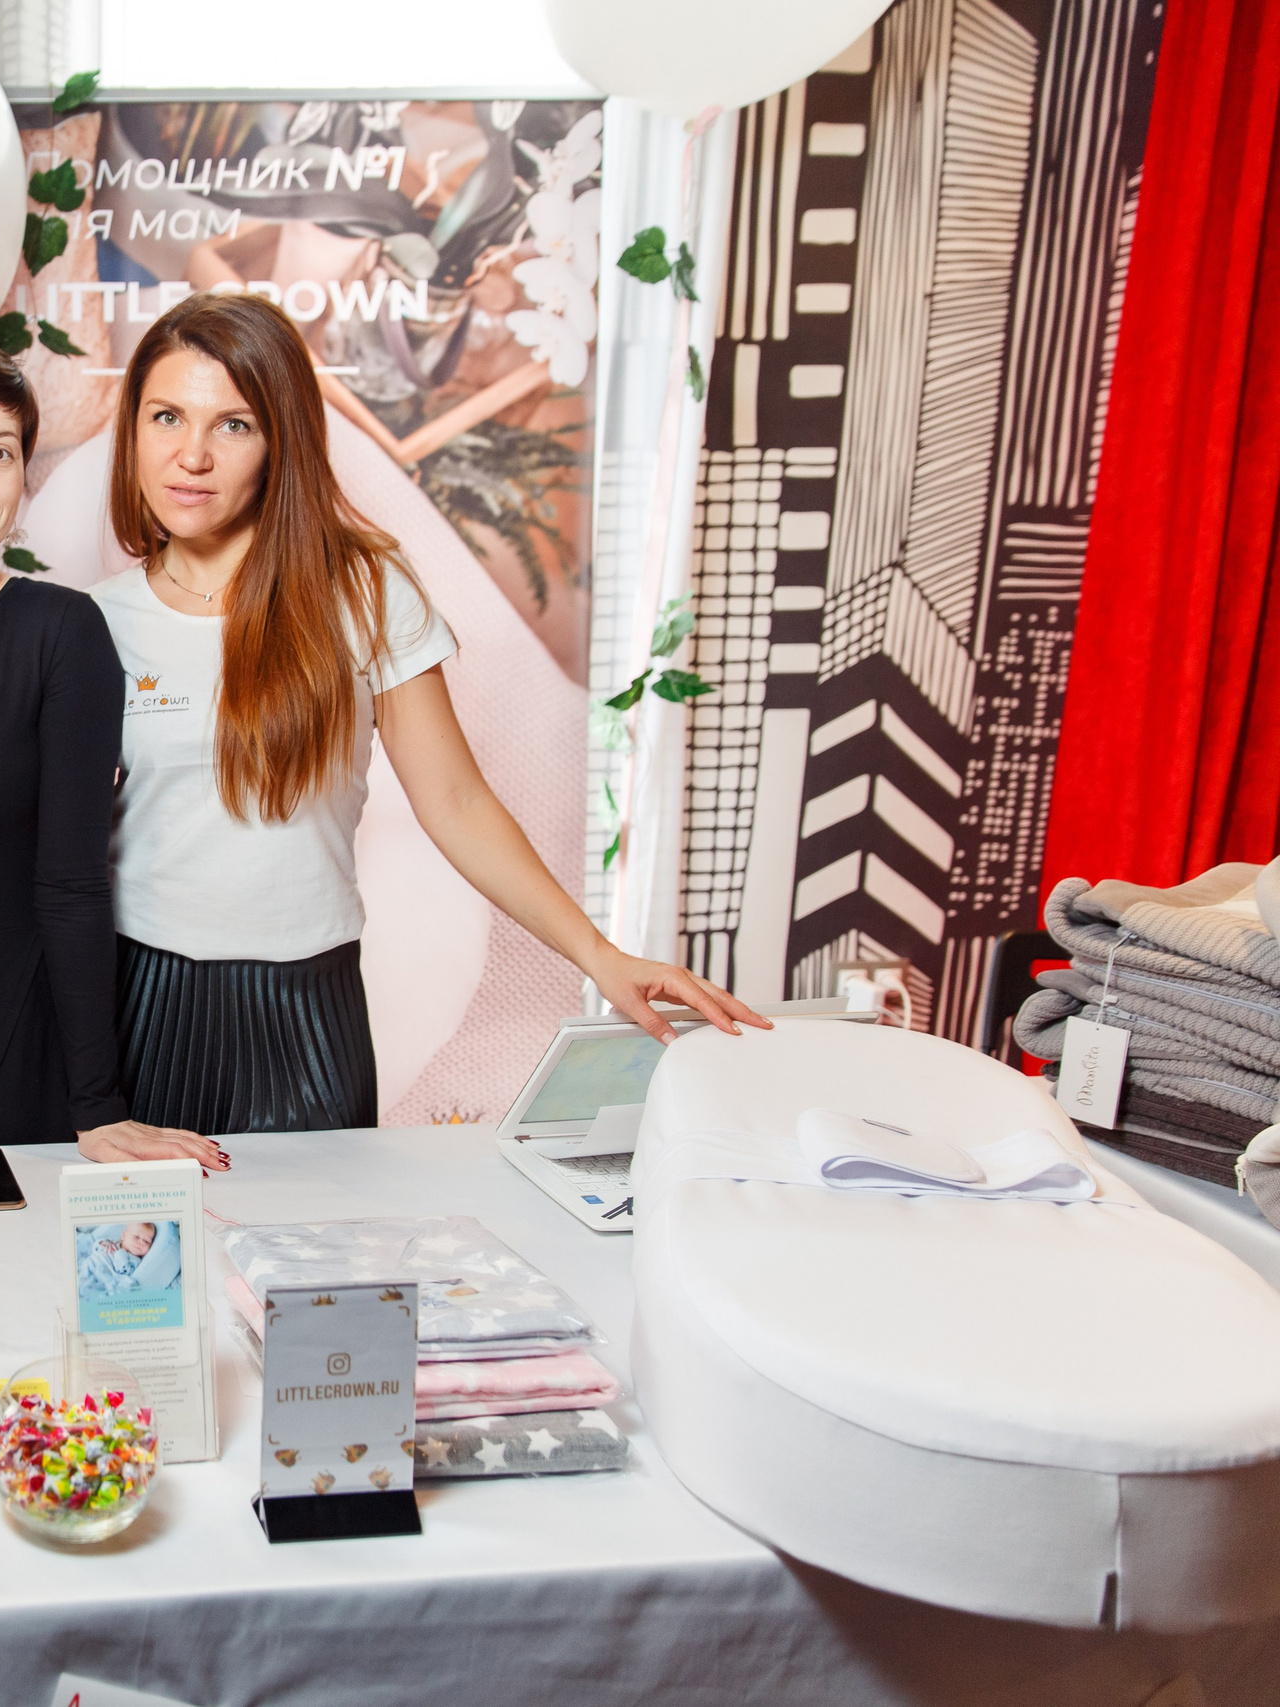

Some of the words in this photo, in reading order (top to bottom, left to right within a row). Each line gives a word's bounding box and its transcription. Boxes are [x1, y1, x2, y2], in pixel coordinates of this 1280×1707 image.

[128, 208, 242, 241] мам
[16, 281, 191, 322] LITTLE
[209, 279, 430, 322] OWN
[143, 695, 190, 707] crown
[152, 1190, 186, 1198] КОКОН
[276, 1379, 400, 1403] LITTLECROWN.RU
